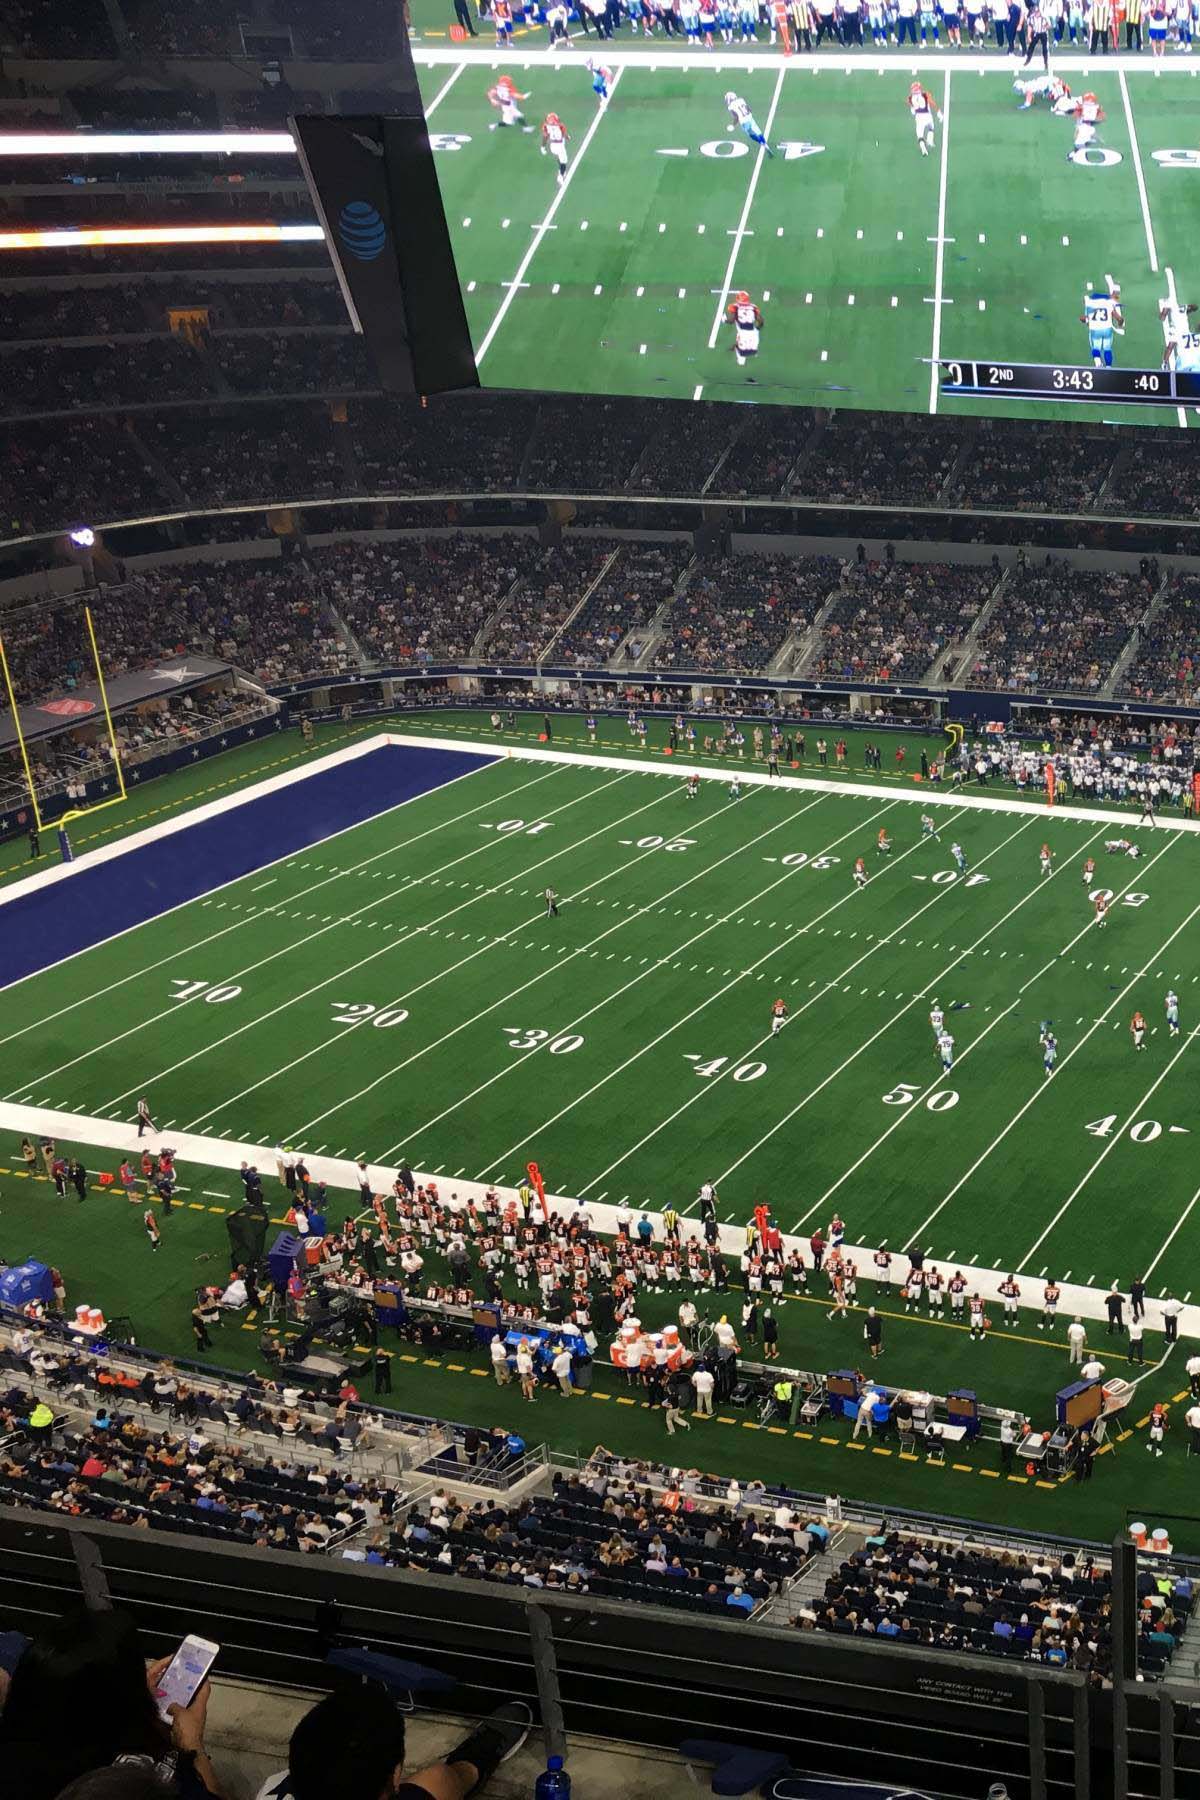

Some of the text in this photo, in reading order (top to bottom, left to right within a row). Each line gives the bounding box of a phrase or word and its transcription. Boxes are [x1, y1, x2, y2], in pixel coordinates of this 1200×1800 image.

[988, 367, 1014, 384] 2ND
[1053, 370, 1094, 391] 3:43
[1134, 375, 1159, 391] :40
[693, 1056, 768, 1082] 40
[881, 1083, 960, 1111] 50
[1085, 1114, 1163, 1142] 40
